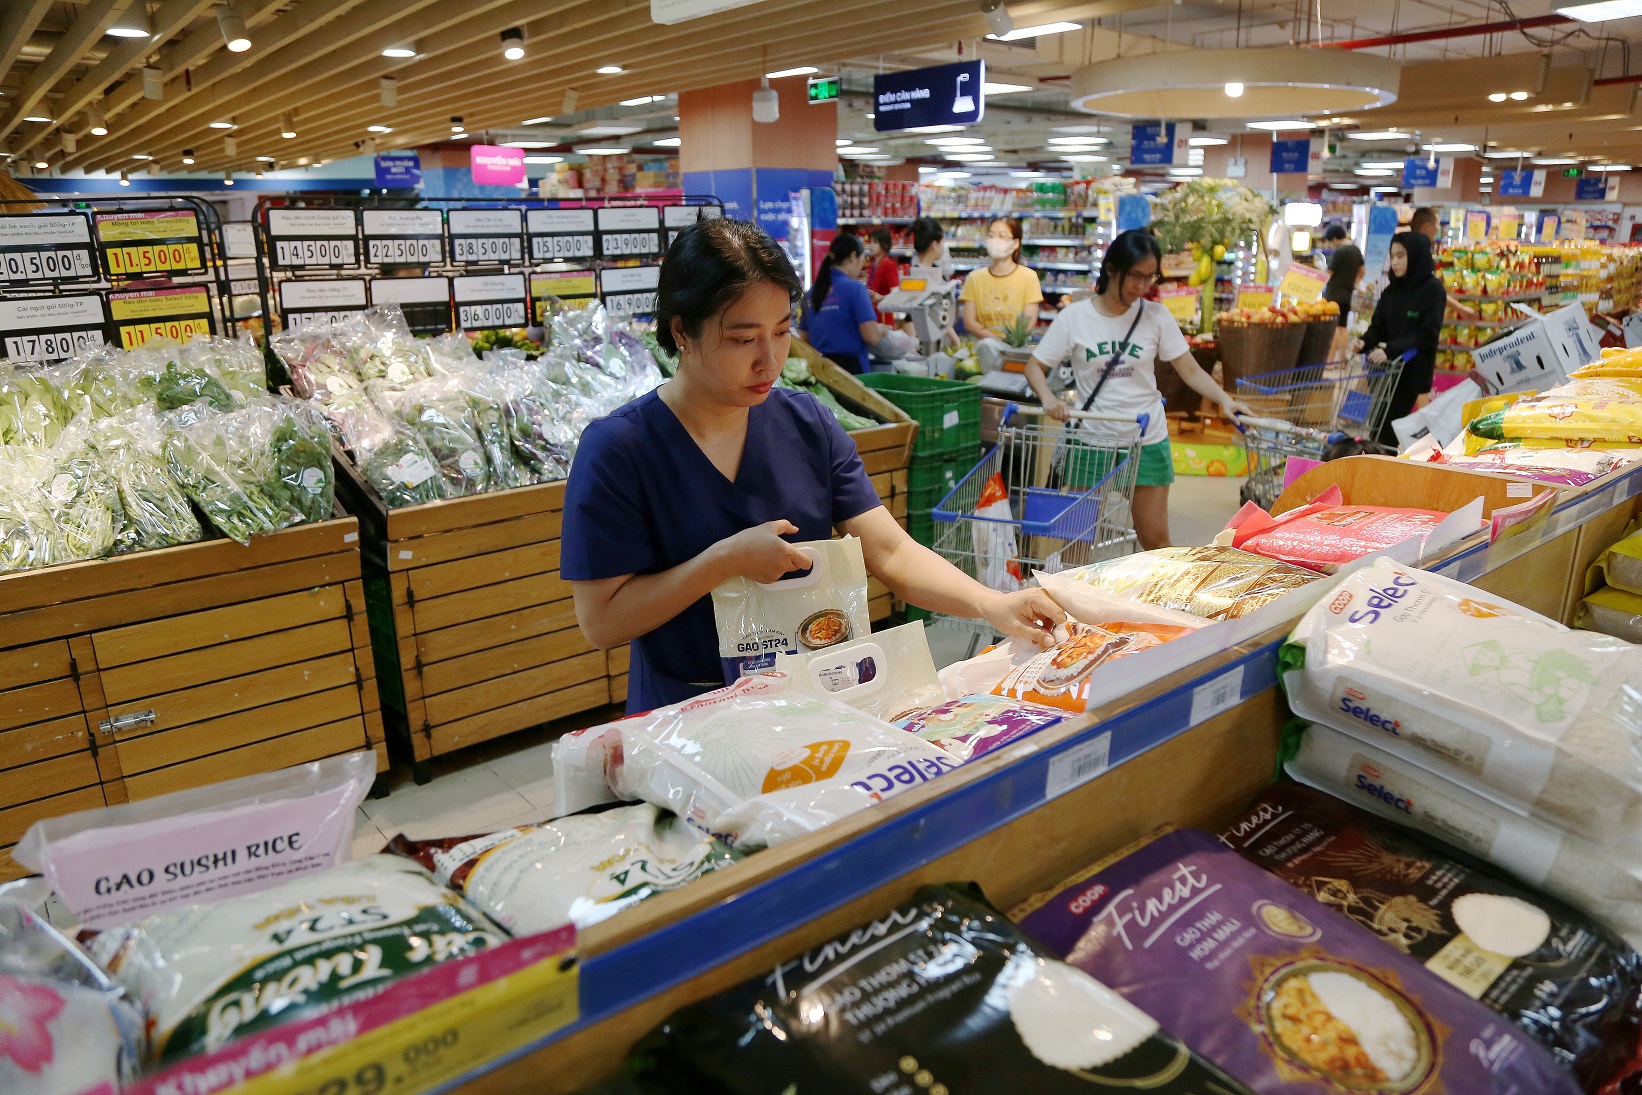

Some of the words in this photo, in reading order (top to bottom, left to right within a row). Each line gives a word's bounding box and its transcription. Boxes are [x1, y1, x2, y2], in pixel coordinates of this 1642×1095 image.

[1177, 139, 1187, 148] 01
[280, 244, 341, 260] 14.500
[372, 244, 428, 258] 22.500
[458, 242, 508, 256] 38.500
[536, 240, 582, 254] 15.500
[605, 238, 648, 252] 23.900
[113, 249, 182, 268] 11.500
[610, 297, 650, 311] 16.900
[462, 307, 512, 322] 36.000
[1479, 331, 1537, 363] Independent
[1330, 591, 1353, 614] COOP
[762, 638, 788, 650] ST24
[1340, 697, 1401, 736] Select
[1355, 774, 1413, 814] Select
[164, 848, 237, 882] SUSHI
[246, 832, 304, 860] RICE
[1069, 884, 1106, 914] COOP
[1092, 862, 1208, 950] Finest
[271, 906, 389, 945] ST24
